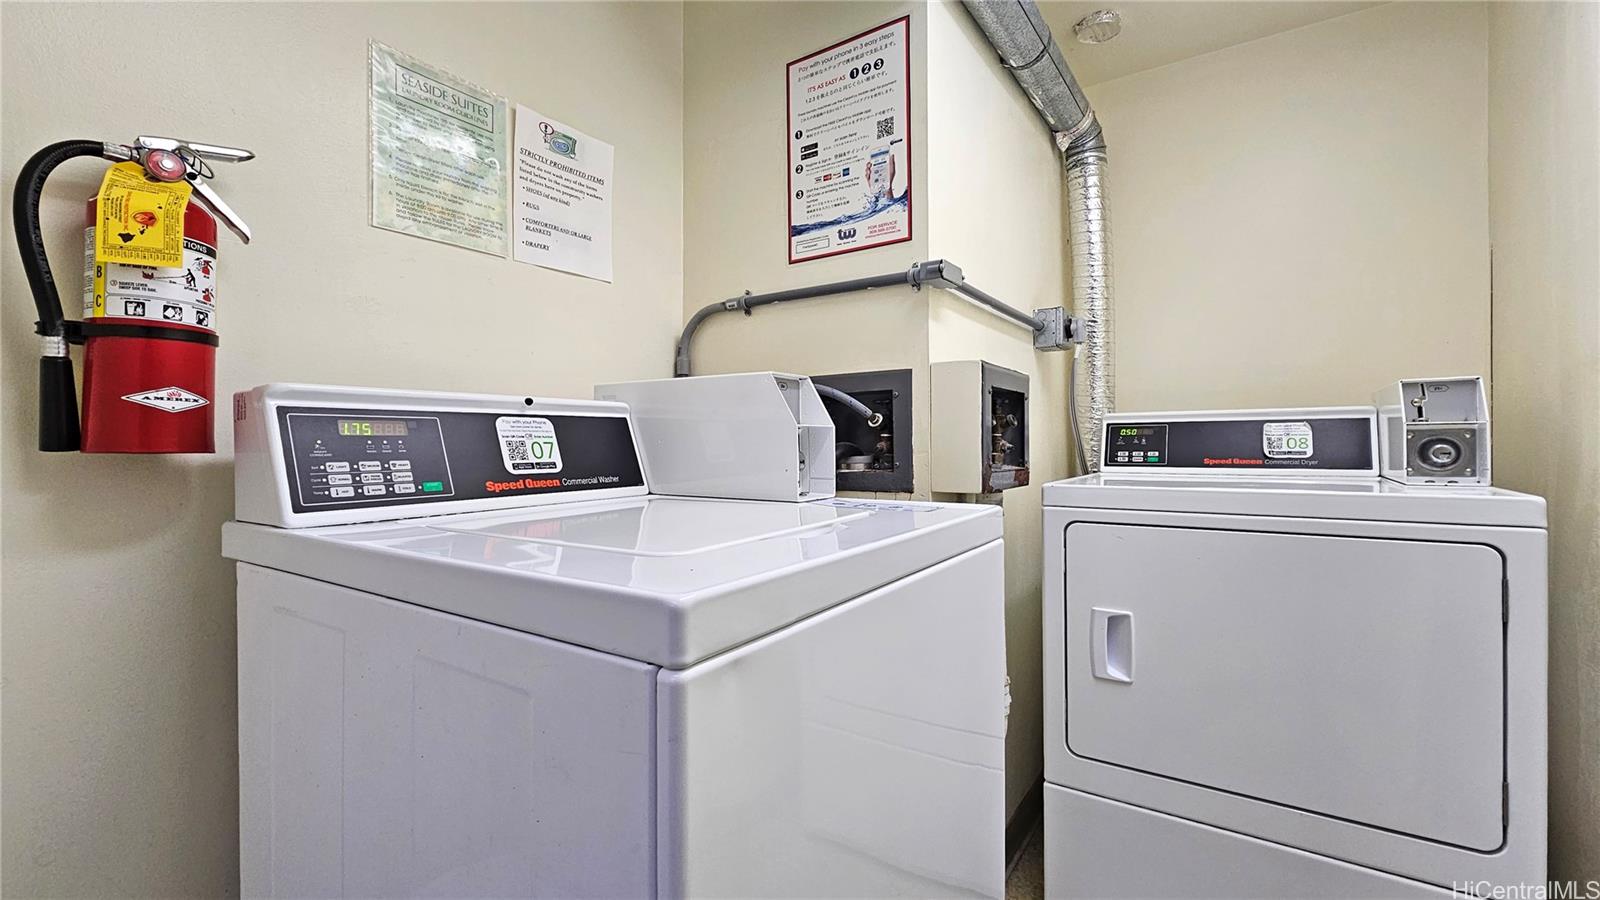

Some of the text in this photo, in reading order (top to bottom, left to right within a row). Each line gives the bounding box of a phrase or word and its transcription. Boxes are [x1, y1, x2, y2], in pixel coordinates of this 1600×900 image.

[798, 31, 895, 74] Pay with your phone in 3 easy steps
[817, 82, 824, 91] AS
[825, 77, 838, 87] EASY
[839, 74, 846, 82] AS
[851, 67, 858, 79] 1
[862, 63, 870, 75] 2
[875, 58, 883, 71] 3
[401, 73, 488, 119] SEASIDE SUITES
[434, 100, 455, 114] ROOM
[520, 147, 605, 186] STRICTLY PROHIBITED ITEMS
[537, 165, 543, 173] do
[544, 168, 552, 176] not
[552, 171, 563, 180] wash
[519, 167, 533, 177] listed
[533, 172, 547, 182] below
[553, 179, 561, 187] the
[519, 174, 528, 183] and
[525, 187, 542, 197] SHOES
[525, 202, 540, 211] RUGS
[525, 218, 560, 232] COMFORTERS
[525, 225, 552, 237] BLANKETS
[525, 240, 550, 252] DRAPERY
[96, 265, 103, 278] B
[96, 295, 102, 307] C
[142, 395, 200, 403] AMEREX
[531, 441, 554, 459] 07
[1286, 437, 1309, 449] 08
[486, 475, 620, 493] Speed Queen Commercial Washer
